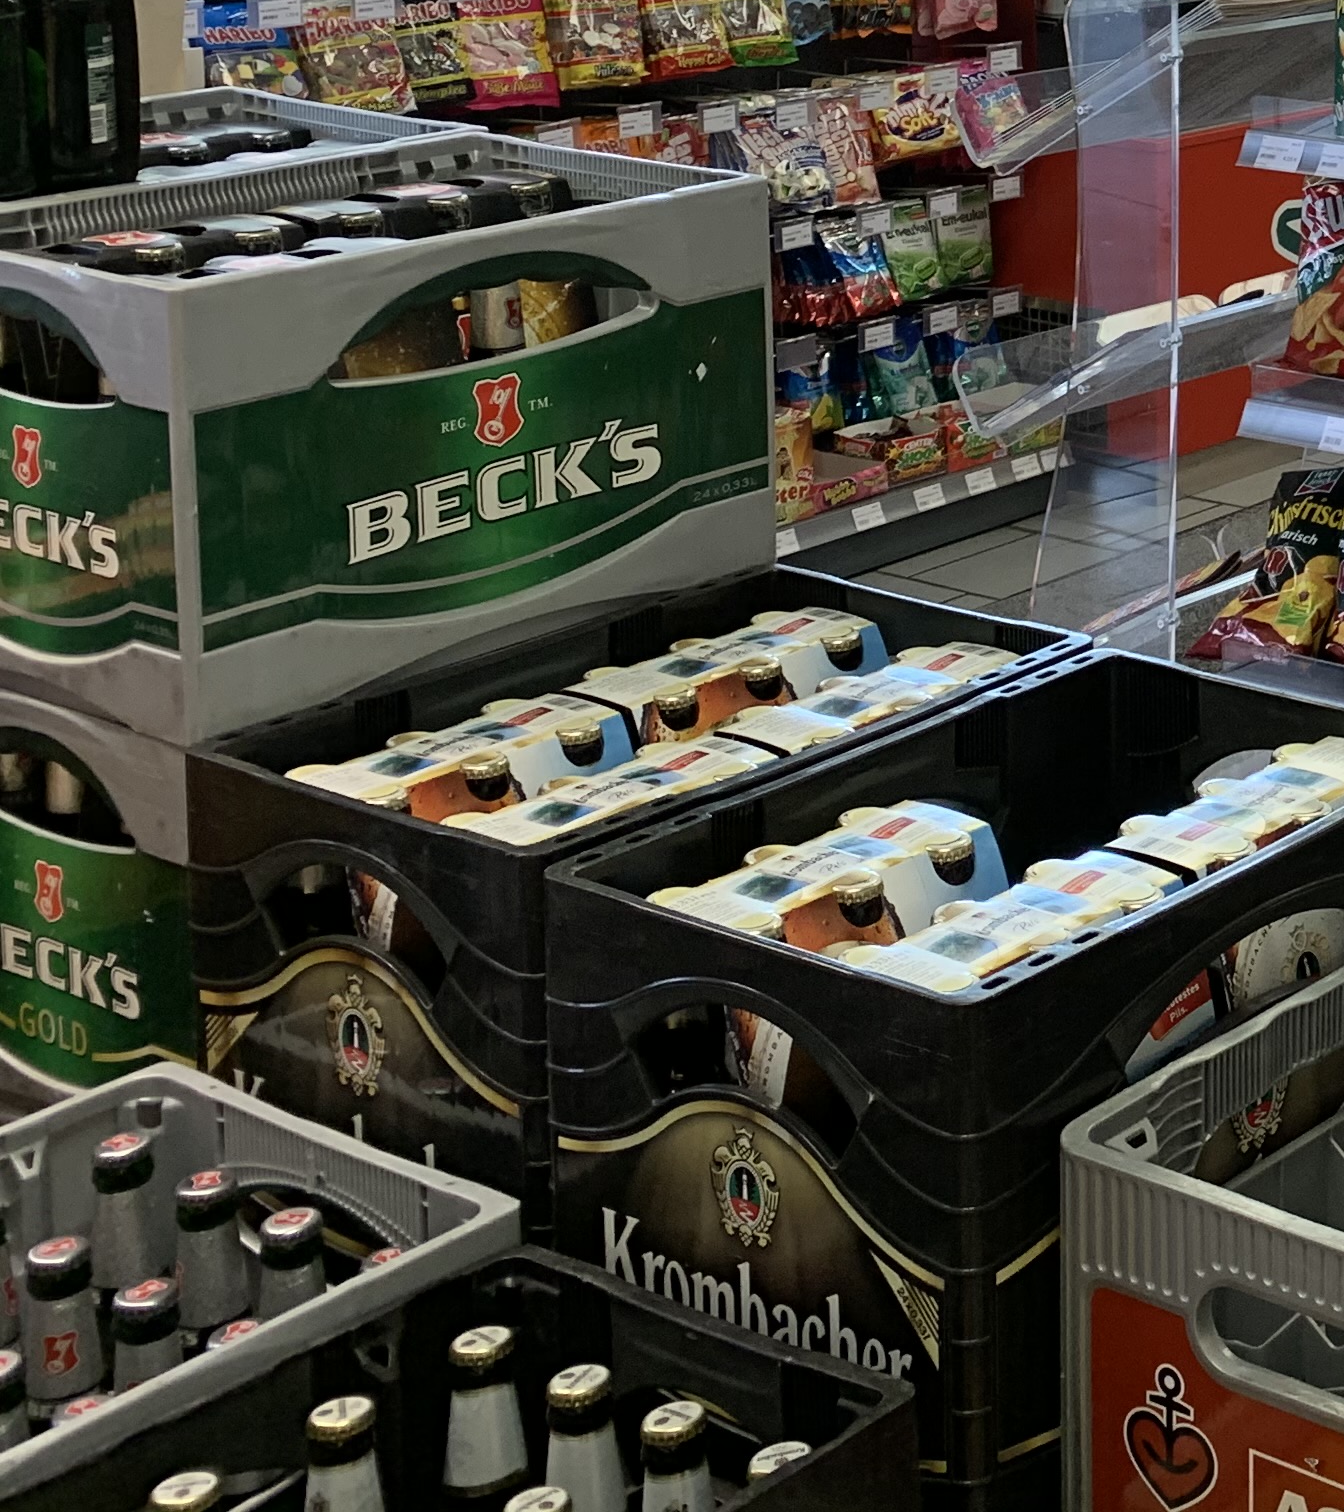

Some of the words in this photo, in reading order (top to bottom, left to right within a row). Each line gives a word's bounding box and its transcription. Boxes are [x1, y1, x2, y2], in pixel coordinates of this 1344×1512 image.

[204, 27, 276, 44] HARIBO
[901, 111, 938, 134] Soft
[941, 207, 988, 226] Em-eukal
[528, 396, 554, 412] TM.
[440, 417, 469, 435] REG.
[346, 417, 664, 567] BECK'S
[0, 497, 120, 580] ECK'S
[0, 927, 142, 1024] ECK'S
[17, 1003, 91, 1058] GOLD
[600, 1205, 914, 1383] Krombacher
